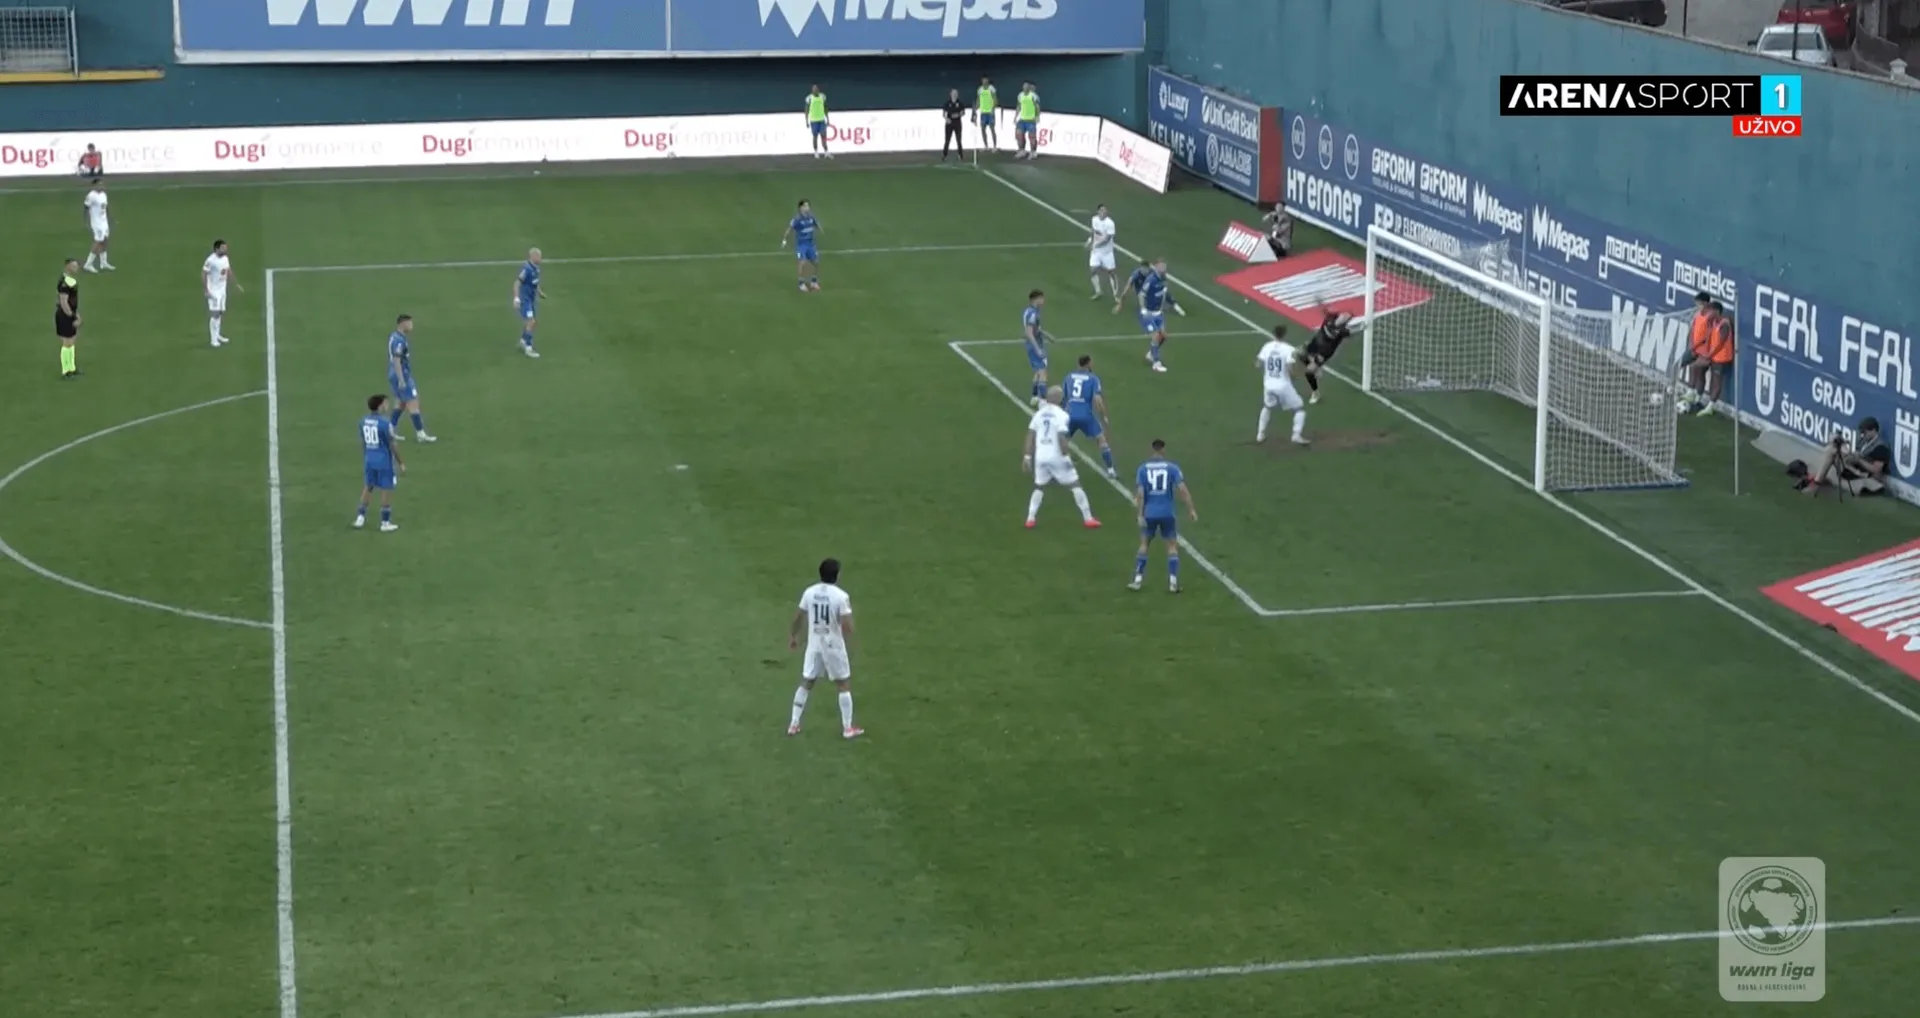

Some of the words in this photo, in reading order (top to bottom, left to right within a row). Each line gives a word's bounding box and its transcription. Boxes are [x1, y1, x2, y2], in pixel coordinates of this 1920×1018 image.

[1150, 120, 1186, 158] KELME
[1487, 196, 1523, 235] Mepas
[1549, 219, 1590, 262] Mepas
[1605, 235, 1662, 275] mandeks
[1674, 260, 1736, 301] mandeks
[1754, 284, 1823, 363] FEAL
[1839, 315, 1918, 399] FEAL
[1072, 379, 1082, 397] 5
[1812, 376, 1856, 416] GRAD
[363, 425, 379, 445] 80
[1780, 392, 1829, 444] ŠIROKI
[1146, 469, 1168, 491] 47
[813, 603, 829, 625] 14
